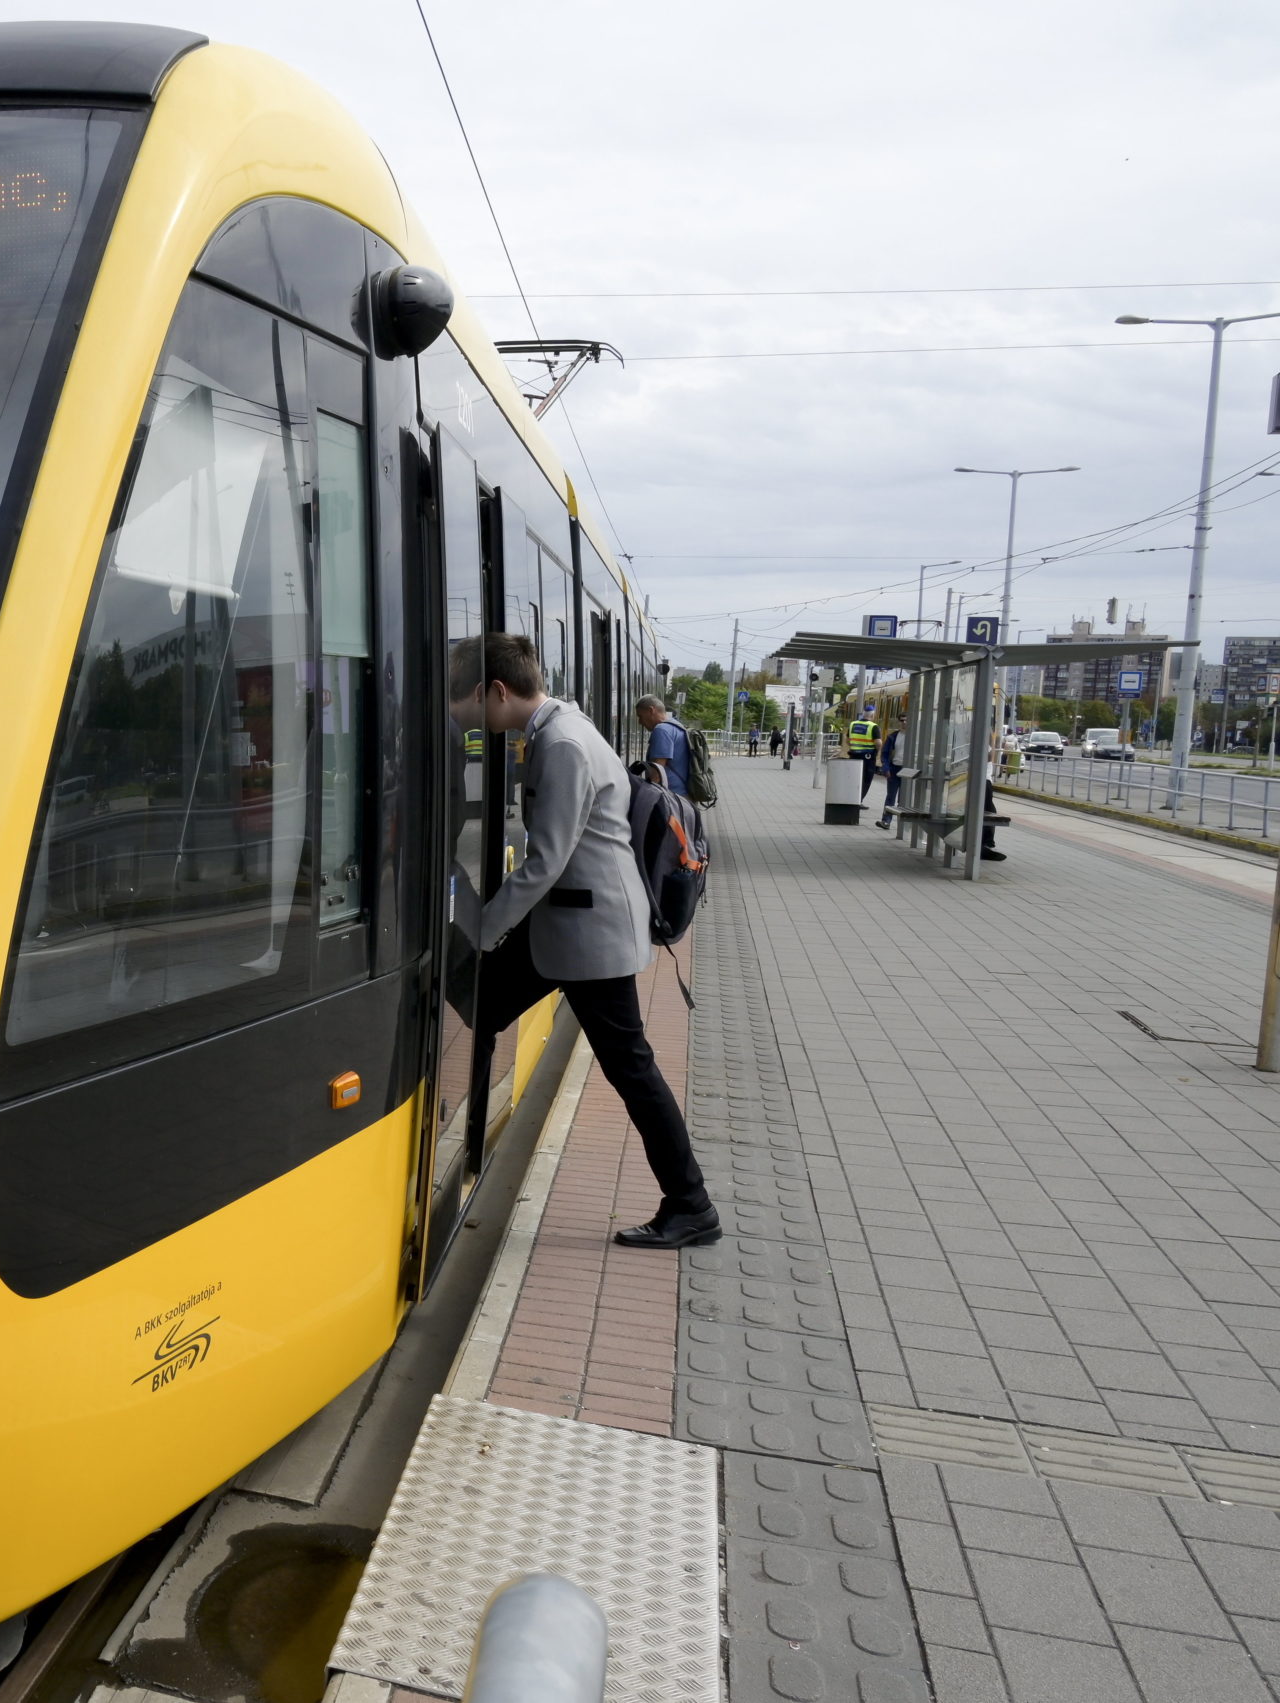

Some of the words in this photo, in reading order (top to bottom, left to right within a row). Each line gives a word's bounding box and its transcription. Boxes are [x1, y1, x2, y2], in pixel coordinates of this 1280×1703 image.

[134, 1326, 142, 1341] A
[144, 1313, 163, 1334] BKK
[165, 1284, 215, 1322] szolgáltatója
[216, 1280, 222, 1292] a
[152, 1361, 178, 1392] BKV
